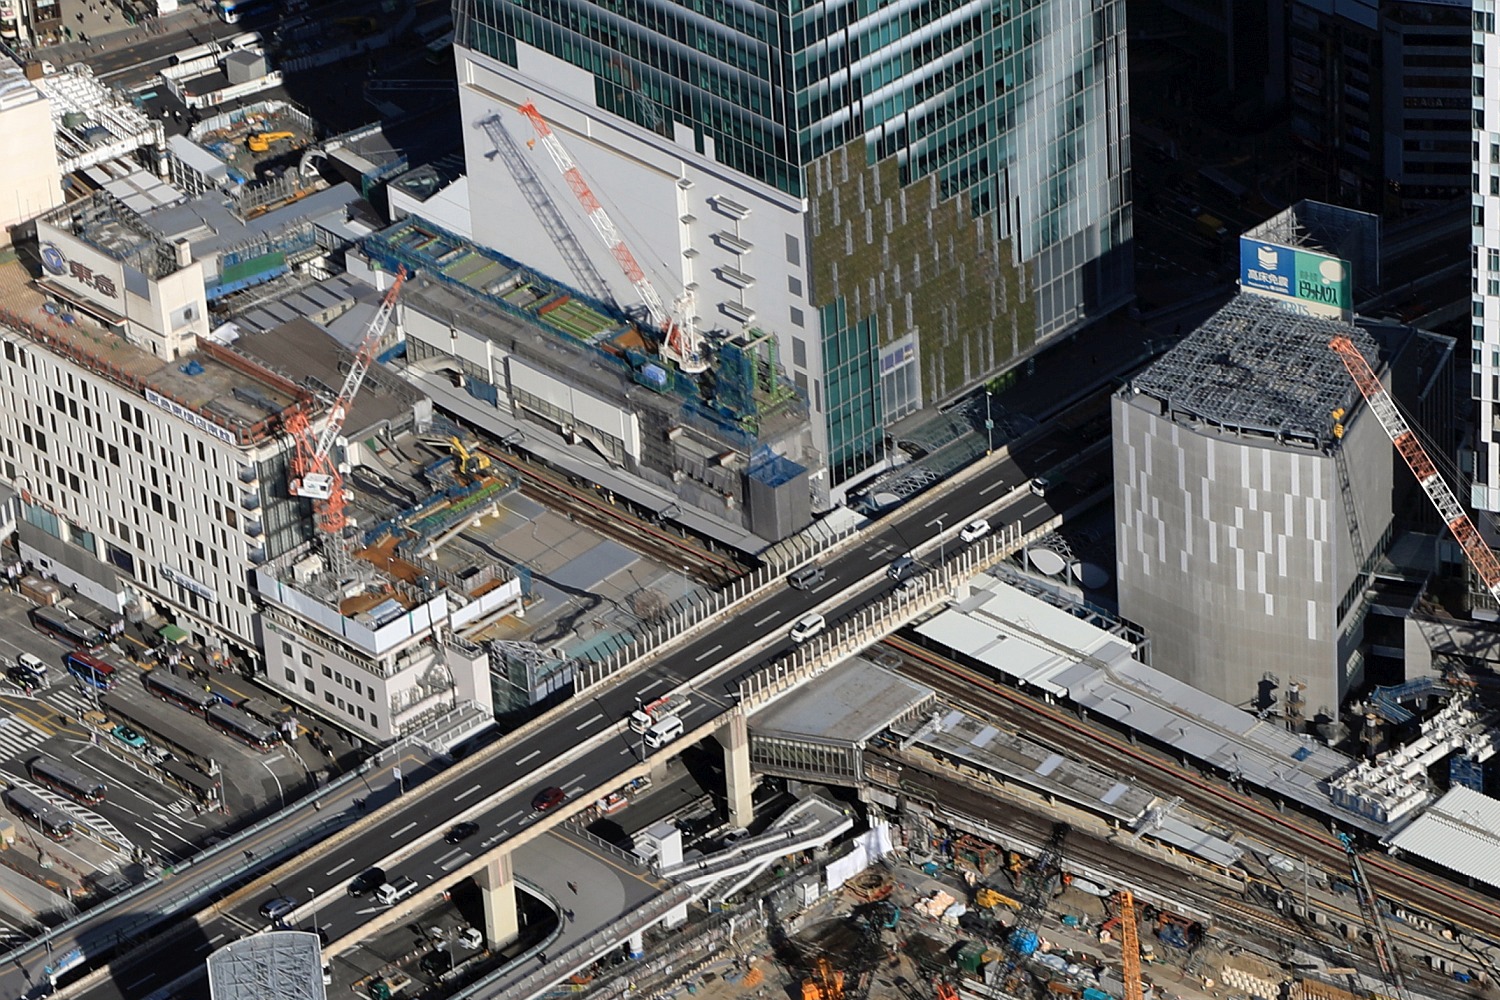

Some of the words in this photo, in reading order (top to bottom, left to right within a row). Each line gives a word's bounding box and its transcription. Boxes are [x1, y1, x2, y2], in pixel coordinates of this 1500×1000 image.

[68, 260, 119, 299] 東急
[1299, 280, 1338, 305] ピタットハウス
